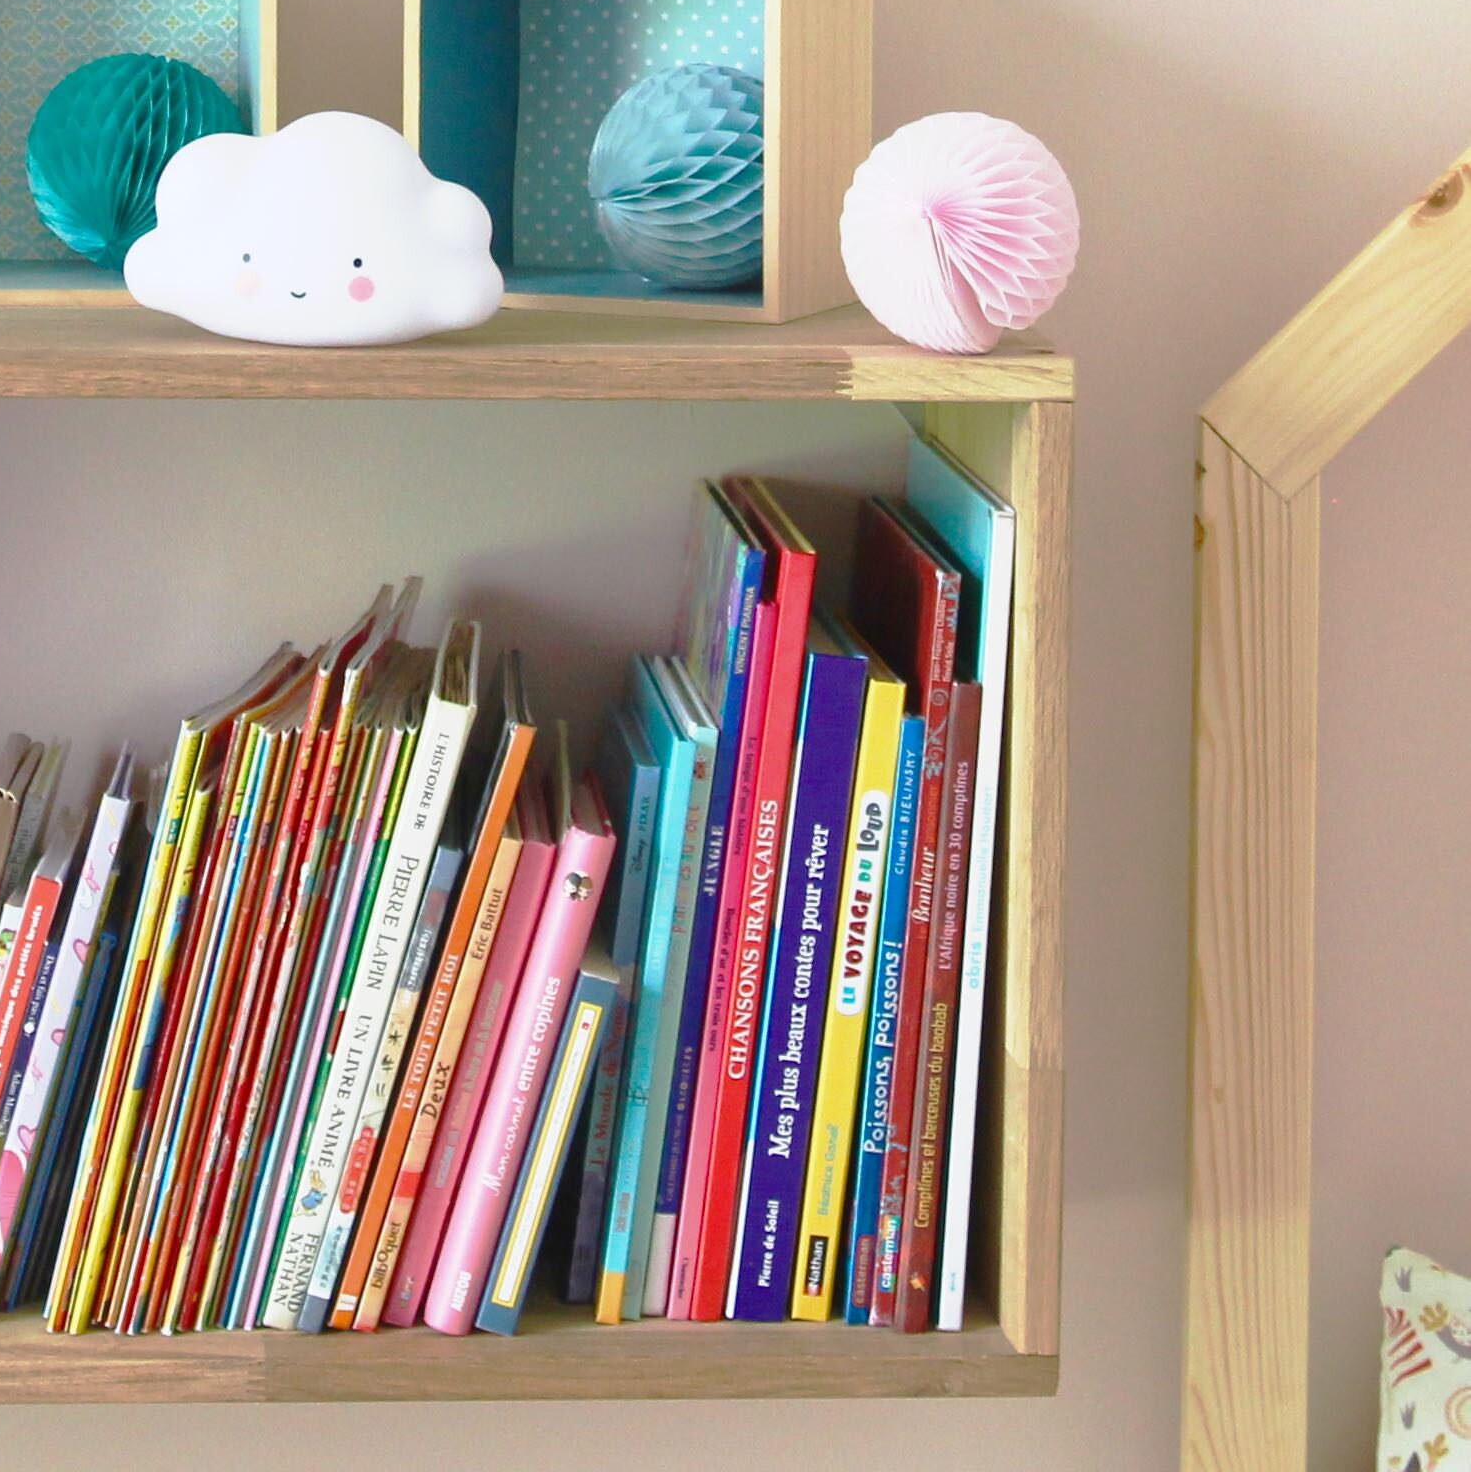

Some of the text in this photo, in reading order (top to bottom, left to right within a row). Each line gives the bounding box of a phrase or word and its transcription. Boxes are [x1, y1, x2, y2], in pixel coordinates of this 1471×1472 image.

[733, 585, 755, 675] VINCENT PIANINA
[418, 732, 450, 808] L'HISTOIRE
[412, 811, 427, 831] DE
[635, 796, 651, 832] PIXAR
[855, 801, 885, 852] LOUP
[893, 749, 918, 875] Claudia BIELINSKY
[382, 855, 419, 928] PIERRE
[702, 824, 724, 897] JUNGLE
[857, 858, 872, 882] DU
[911, 846, 935, 921] Bonheur
[936, 762, 970, 969] L'Afrique noire en 30 comptines
[23, 903, 45, 942] bruits
[469, 886, 504, 961] Éric Battut
[727, 799, 780, 1080] CHANSONS FRANÇAISES
[843, 889, 871, 979] VOYAGE
[7, 976, 23, 998] des
[13, 941, 35, 977] petits
[365, 934, 397, 990] LAPIN
[766, 823, 833, 1158] Mes plus beaux contes pour rêver
[352, 1013, 371, 1041] UN
[401, 952, 459, 1109] LE TOUT PETIT ROI
[527, 975, 567, 1044] copines
[335, 1046, 363, 1100] LIVRE
[420, 1061, 453, 1121] Deux
[514, 1045, 543, 1093] entre
[316, 1103, 350, 1170] ANIMÉ
[497, 1094, 530, 1151] carnet
[863, 1055, 893, 1154] Poissons,
[913, 1003, 947, 1227] Comptines et berceuses du baobab
[476, 1147, 512, 1196] Mon
[271, 1231, 304, 1305] NATHAN
[283, 1232, 320, 1314] FERNAND
[756, 1199, 780, 1286] Pierre de Soleil
[806, 1239, 824, 1288] Nathan
[853, 1237, 872, 1304] casterman
[879, 1219, 898, 1289] casterman
[447, 1269, 473, 1311] AUZOU
